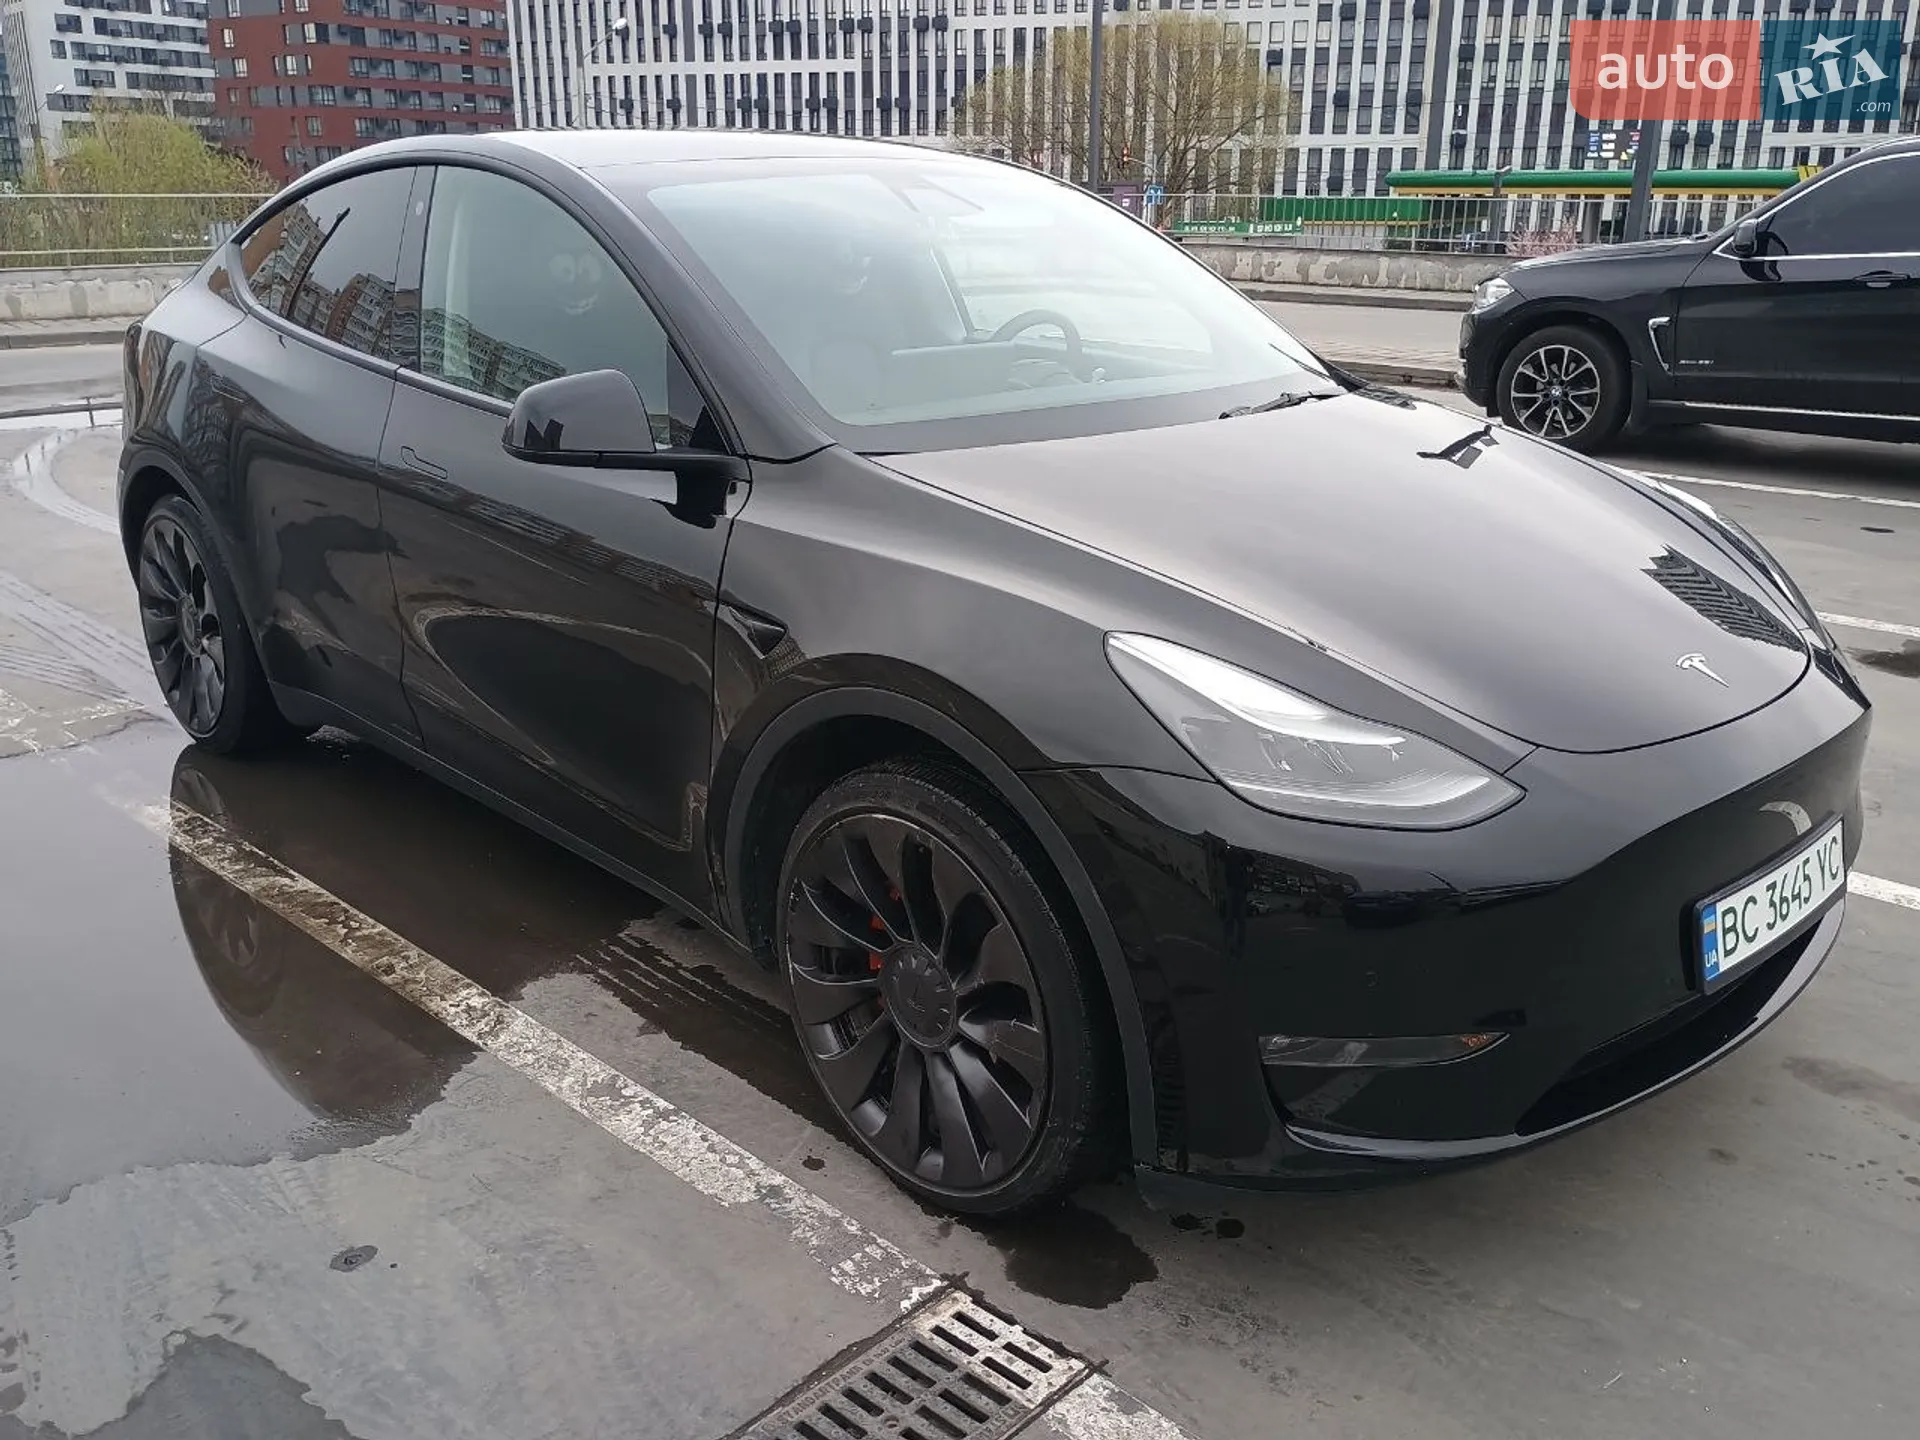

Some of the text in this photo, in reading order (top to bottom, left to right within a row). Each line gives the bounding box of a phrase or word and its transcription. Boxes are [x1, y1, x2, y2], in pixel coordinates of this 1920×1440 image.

[1721, 835, 1840, 958] BC 3645 YC
[1705, 951, 1718, 967] UA
